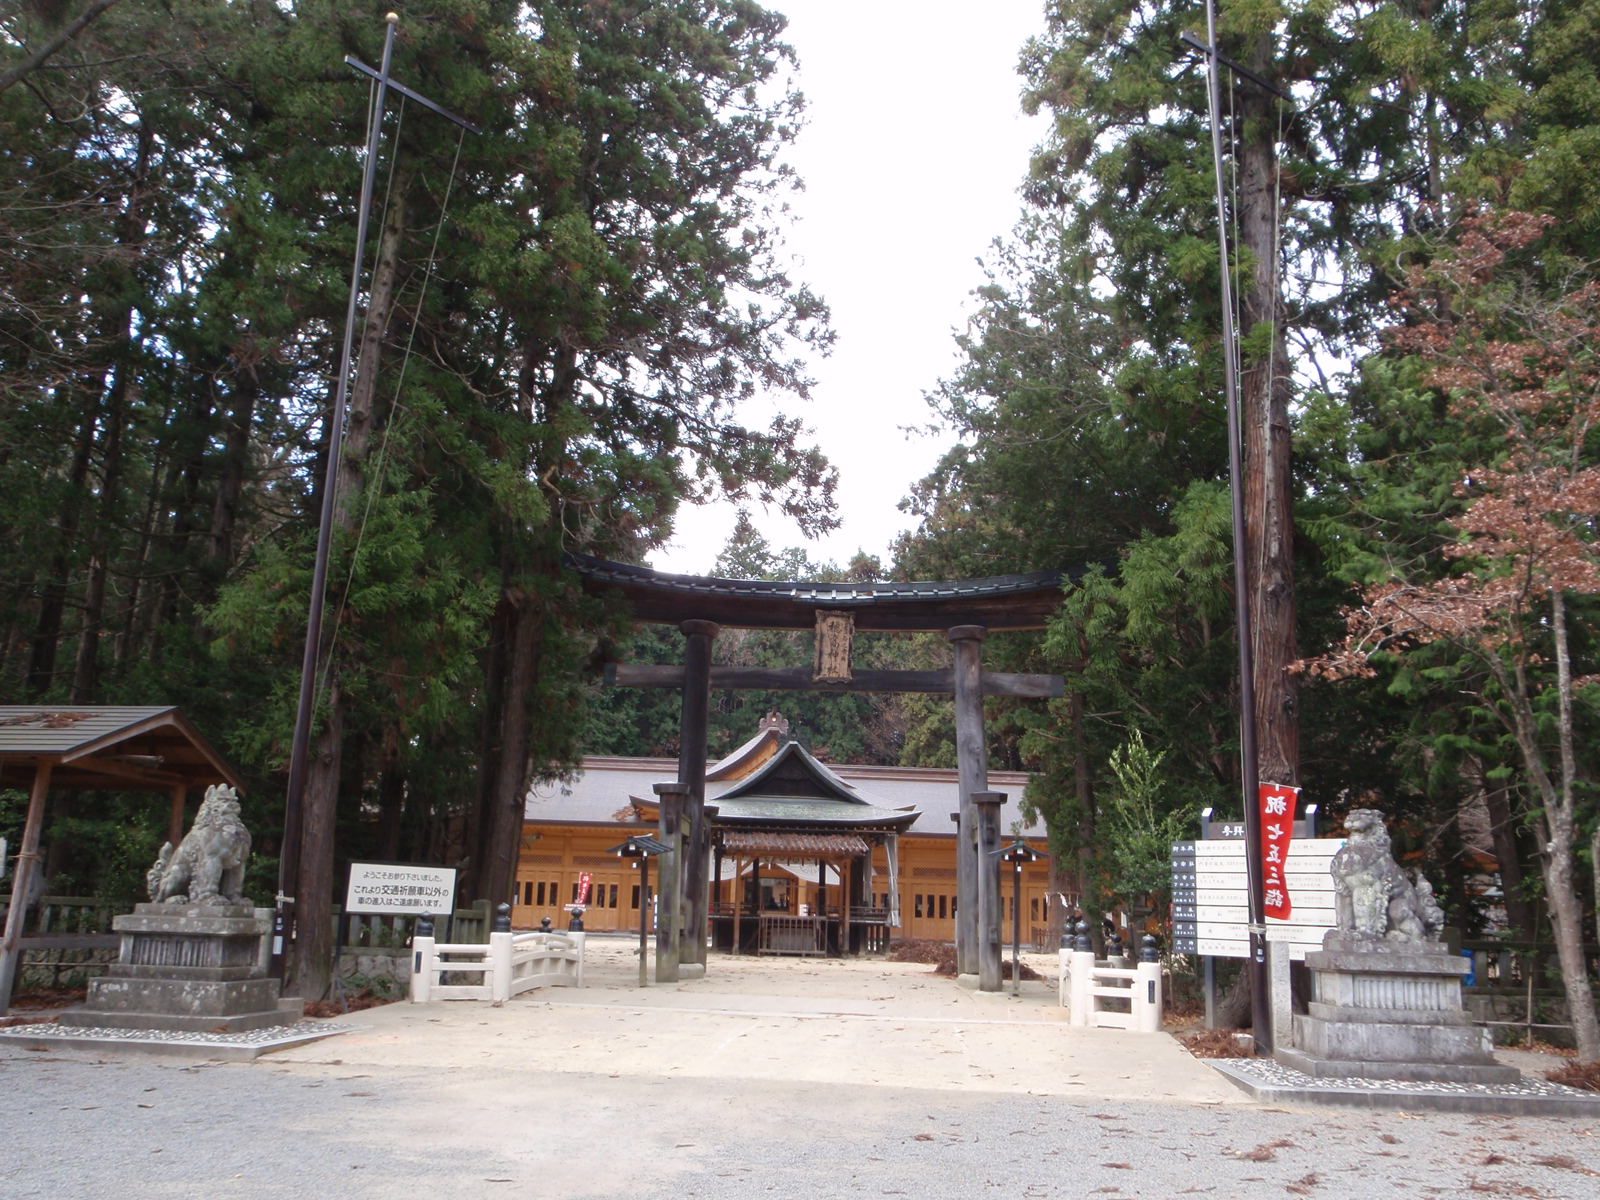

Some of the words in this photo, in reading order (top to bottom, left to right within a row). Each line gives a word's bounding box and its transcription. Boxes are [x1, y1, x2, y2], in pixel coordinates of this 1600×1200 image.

[363, 871, 443, 882] ようこそお参り下さいました。
[354, 885, 449, 897] これより交通祈願車以外の
